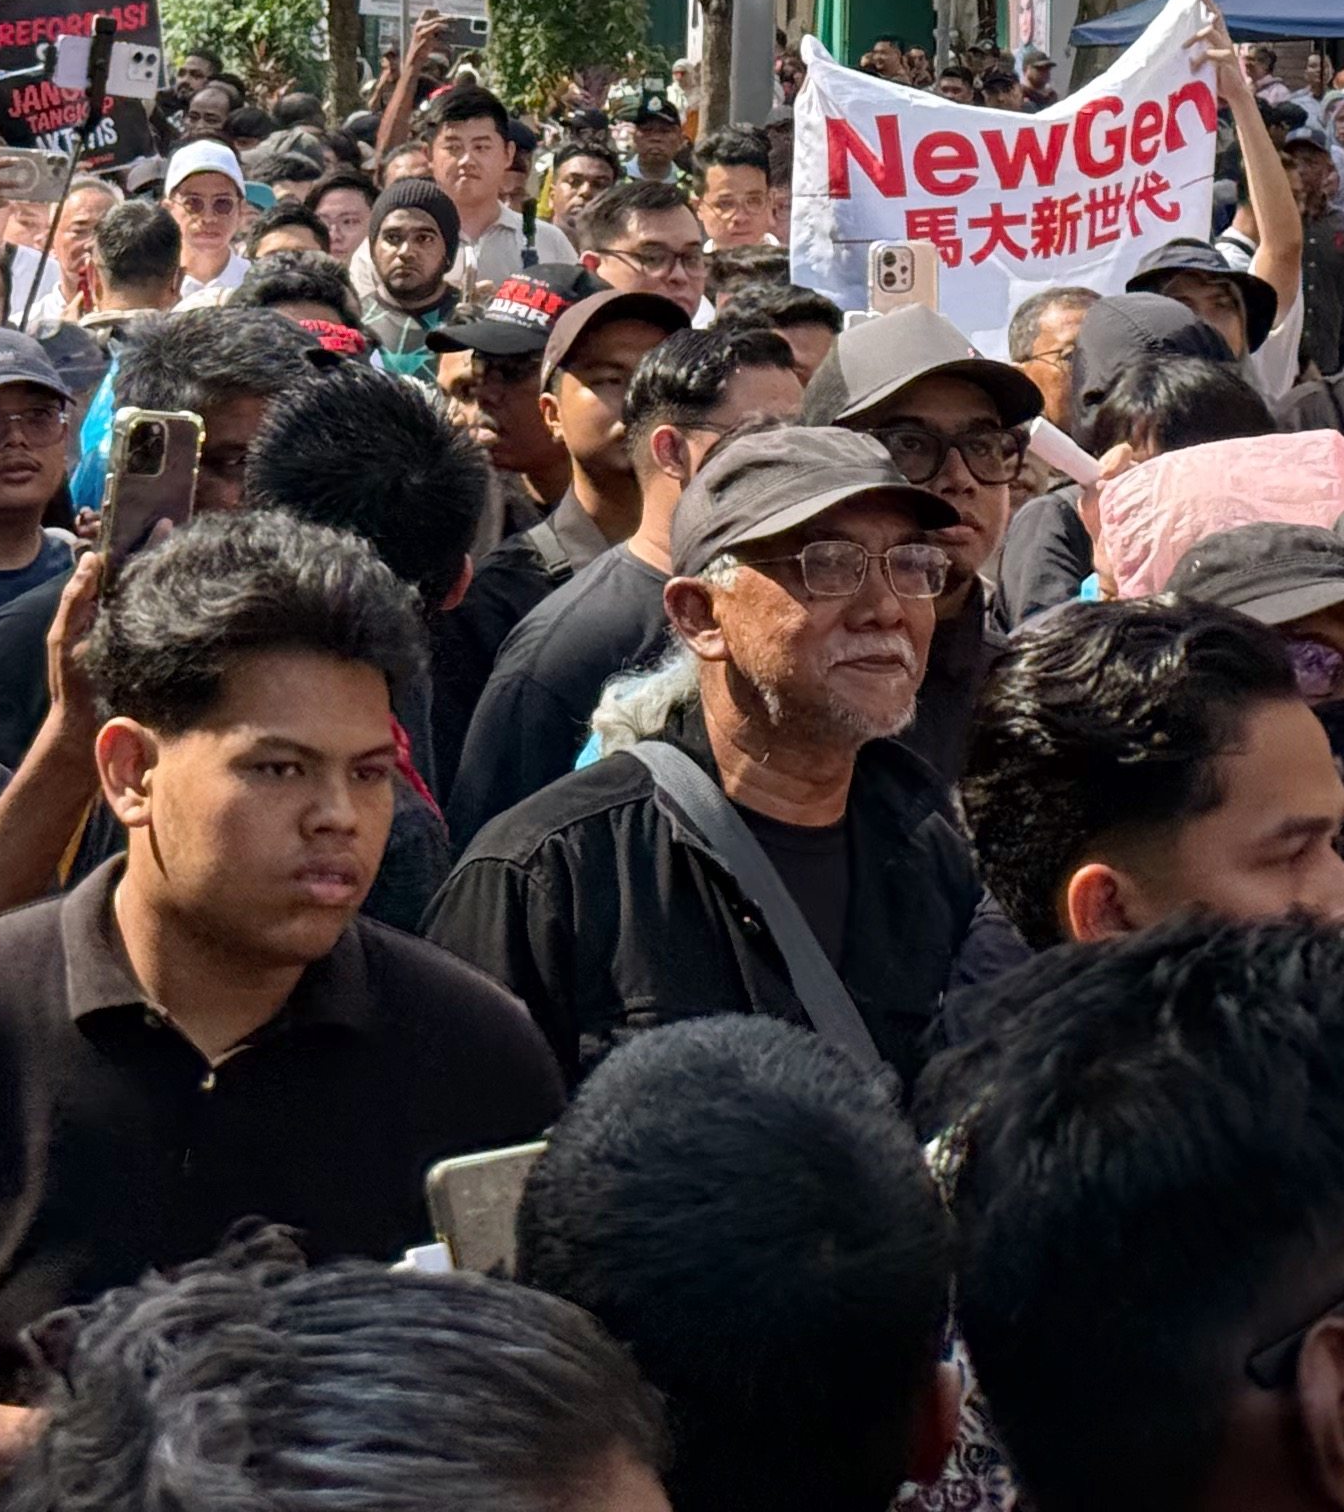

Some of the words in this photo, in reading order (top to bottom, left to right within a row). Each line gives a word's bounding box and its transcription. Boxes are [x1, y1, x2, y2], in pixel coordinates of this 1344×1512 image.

[27, 95, 115, 134] TANGKP
[826, 80, 1218, 201] NewGen
[905, 170, 1182, 269] 馬大新世代
